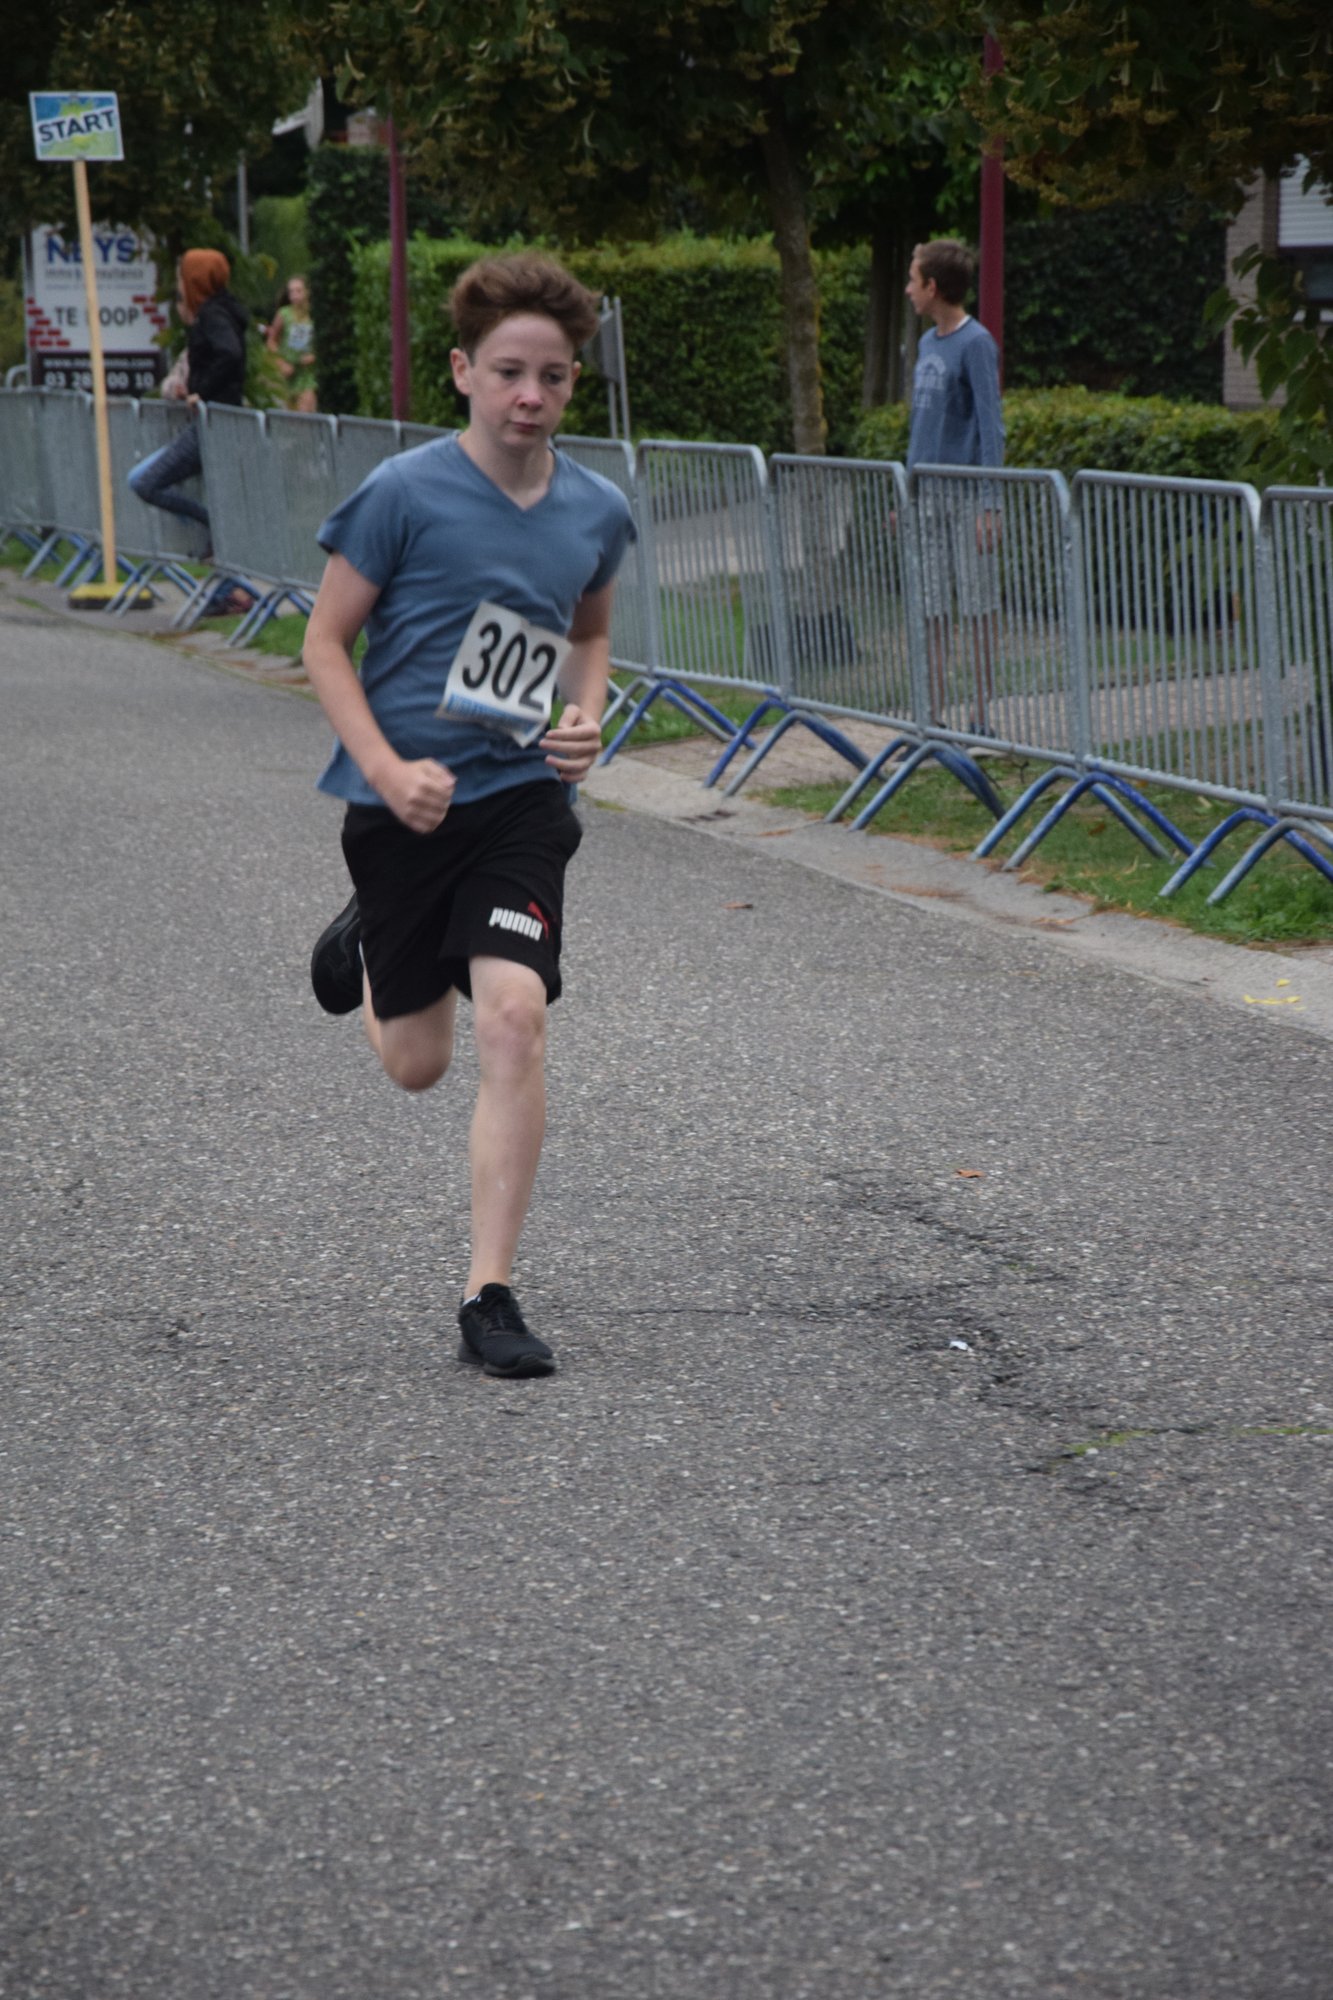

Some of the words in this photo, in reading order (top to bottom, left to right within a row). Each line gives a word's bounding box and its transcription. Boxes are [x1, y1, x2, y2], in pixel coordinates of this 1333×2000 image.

[38, 109, 115, 143] START
[54, 305, 77, 326] TE
[86, 305, 139, 326] OOP
[462, 620, 557, 714] 302
[488, 906, 543, 942] PUMA
